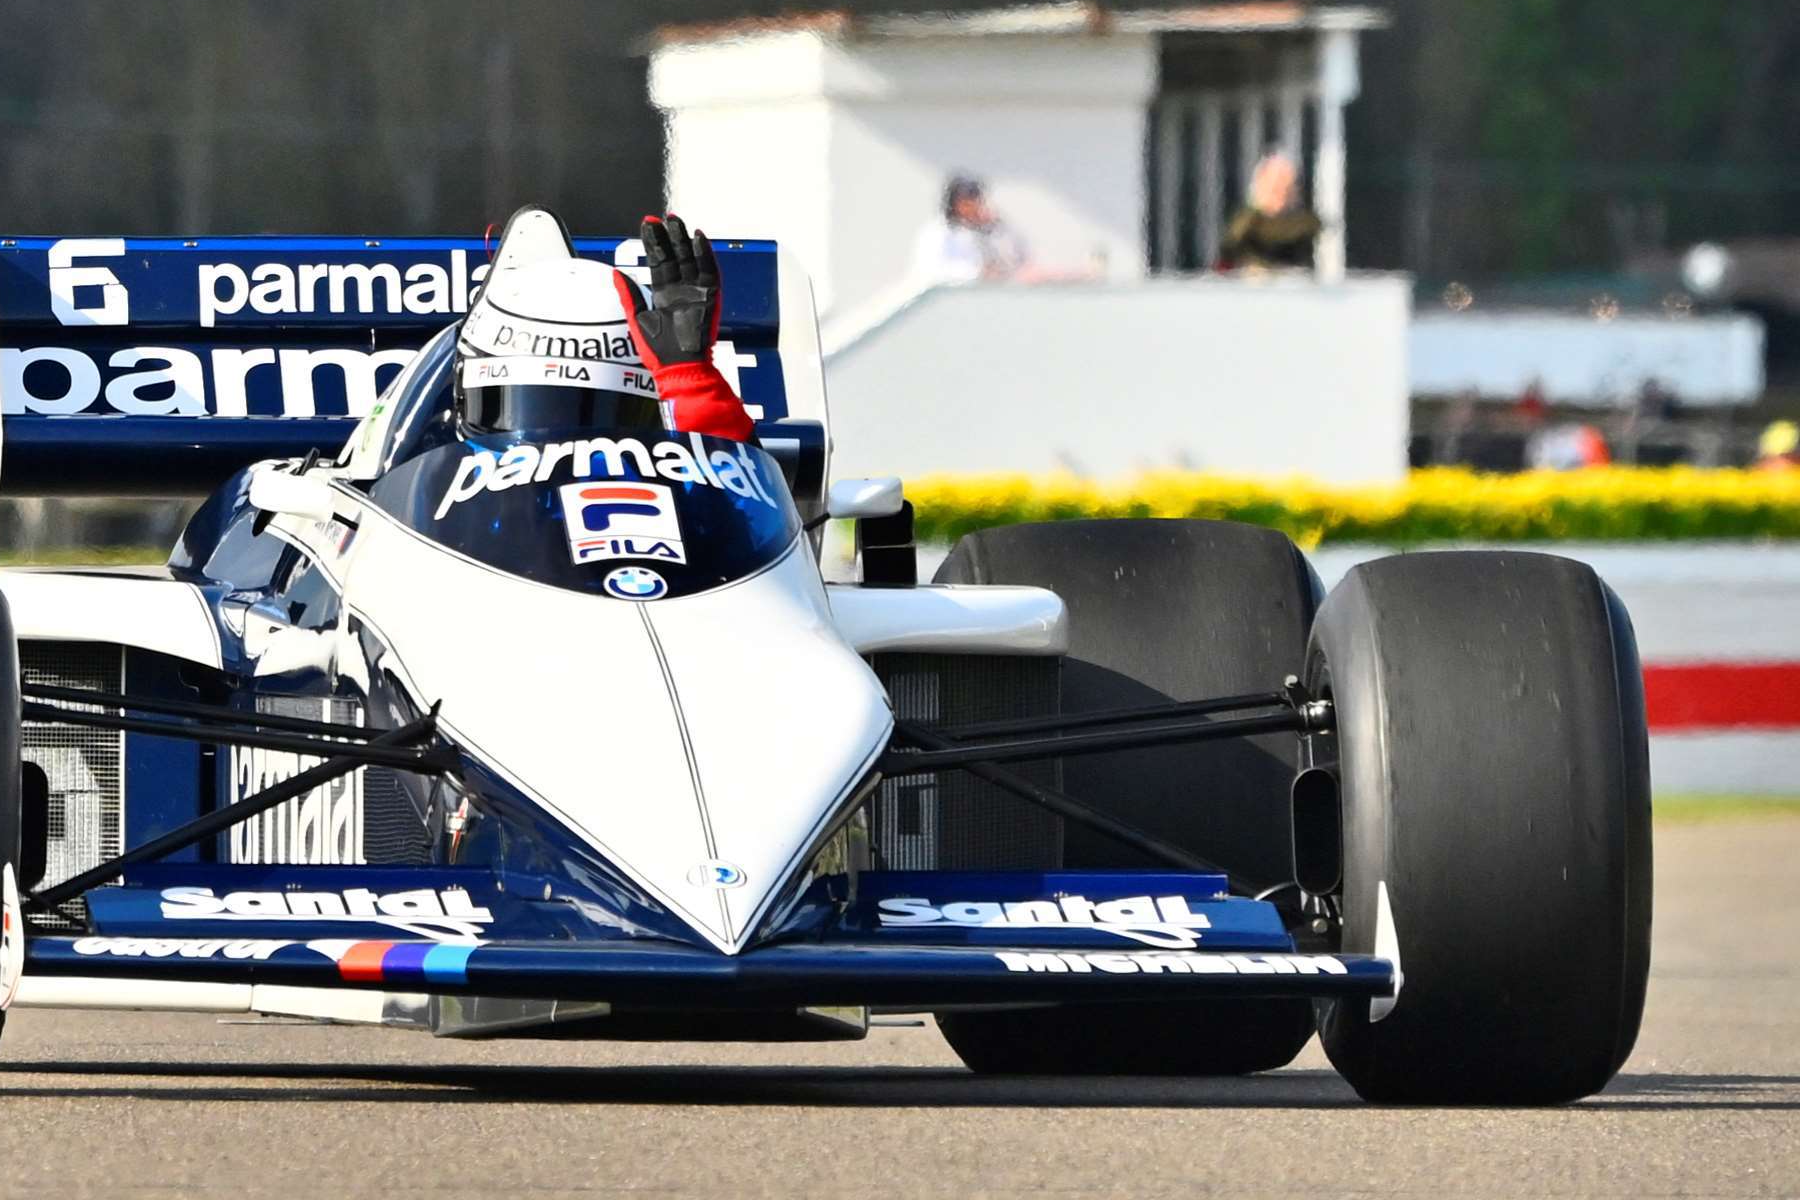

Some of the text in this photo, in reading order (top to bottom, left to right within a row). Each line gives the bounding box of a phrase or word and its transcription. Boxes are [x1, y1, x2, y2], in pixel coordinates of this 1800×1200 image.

[48, 238, 129, 325] 6
[478, 364, 509, 380] FILA
[544, 364, 591, 381] FILA
[434, 432, 778, 521] parmalat
[578, 539, 681, 560] FILA
